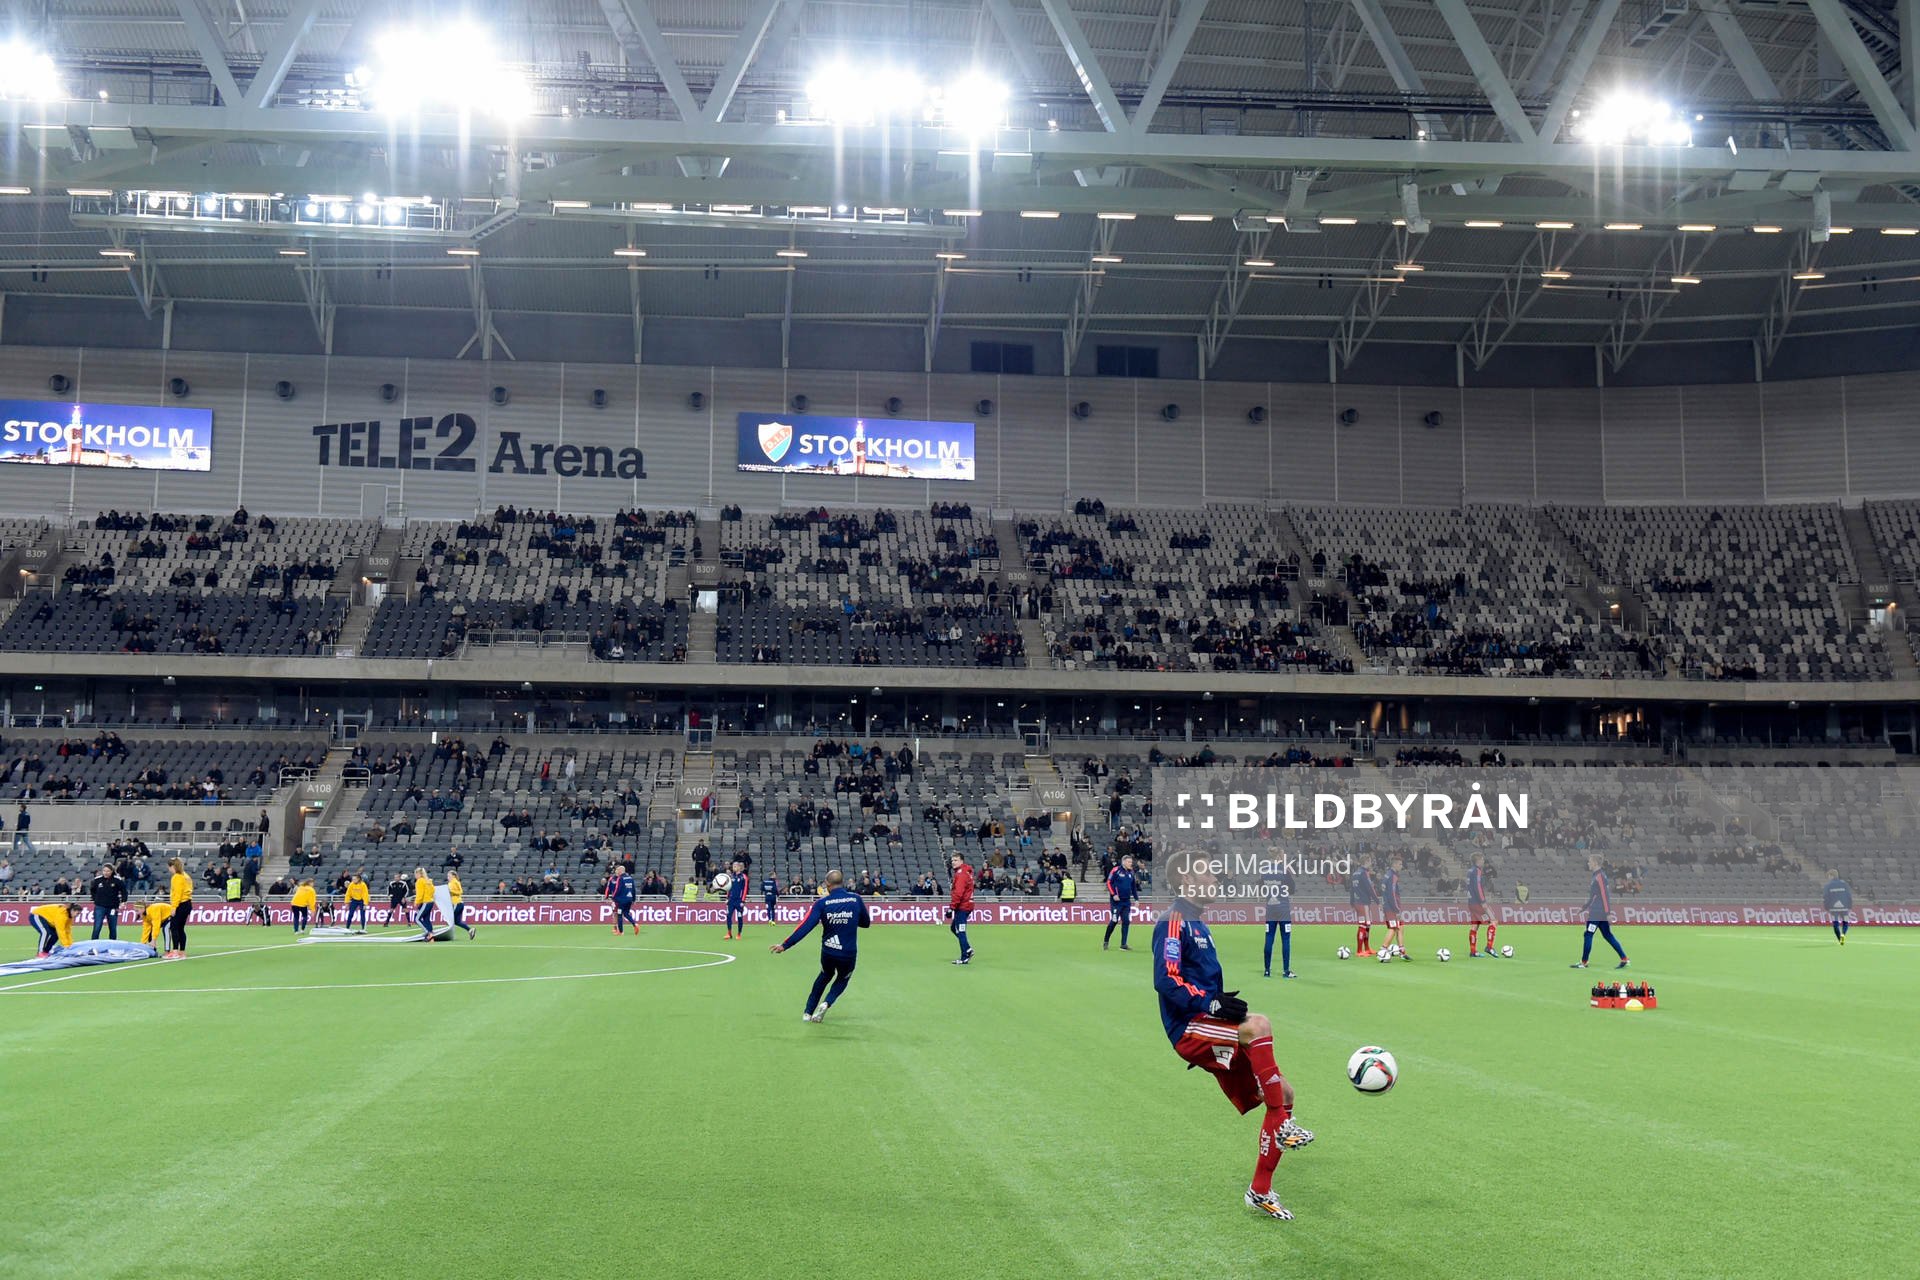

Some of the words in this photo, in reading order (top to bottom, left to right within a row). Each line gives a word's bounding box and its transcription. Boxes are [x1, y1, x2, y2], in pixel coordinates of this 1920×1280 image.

[3, 420, 194, 448] STOCKHOLM
[312, 413, 477, 473] TELE2
[488, 431, 647, 480] Arena
[799, 434, 960, 459] STOCKHOLM
[25, 549, 48, 558] B309
[696, 565, 716, 574] B307
[306, 784, 332, 793] A108
[684, 787, 709, 796] A107
[1043, 790, 1066, 799] A106
[189, 905, 252, 922] rioritet
[461, 905, 536, 922] Prioritet
[538, 905, 592, 922] Finans
[675, 905, 727, 922] Finans
[869, 905, 939, 922] Prioritet
[1000, 905, 1068, 922] Prioritet
[1071, 905, 1121, 922] Finan
[1502, 907, 1567, 923] Prioritet
[1623, 907, 1688, 923] Prioritet
[1690, 908, 1739, 923] Finans
[1742, 907, 1810, 923] Prioritet
[1260, 1128, 1271, 1157] SKF
